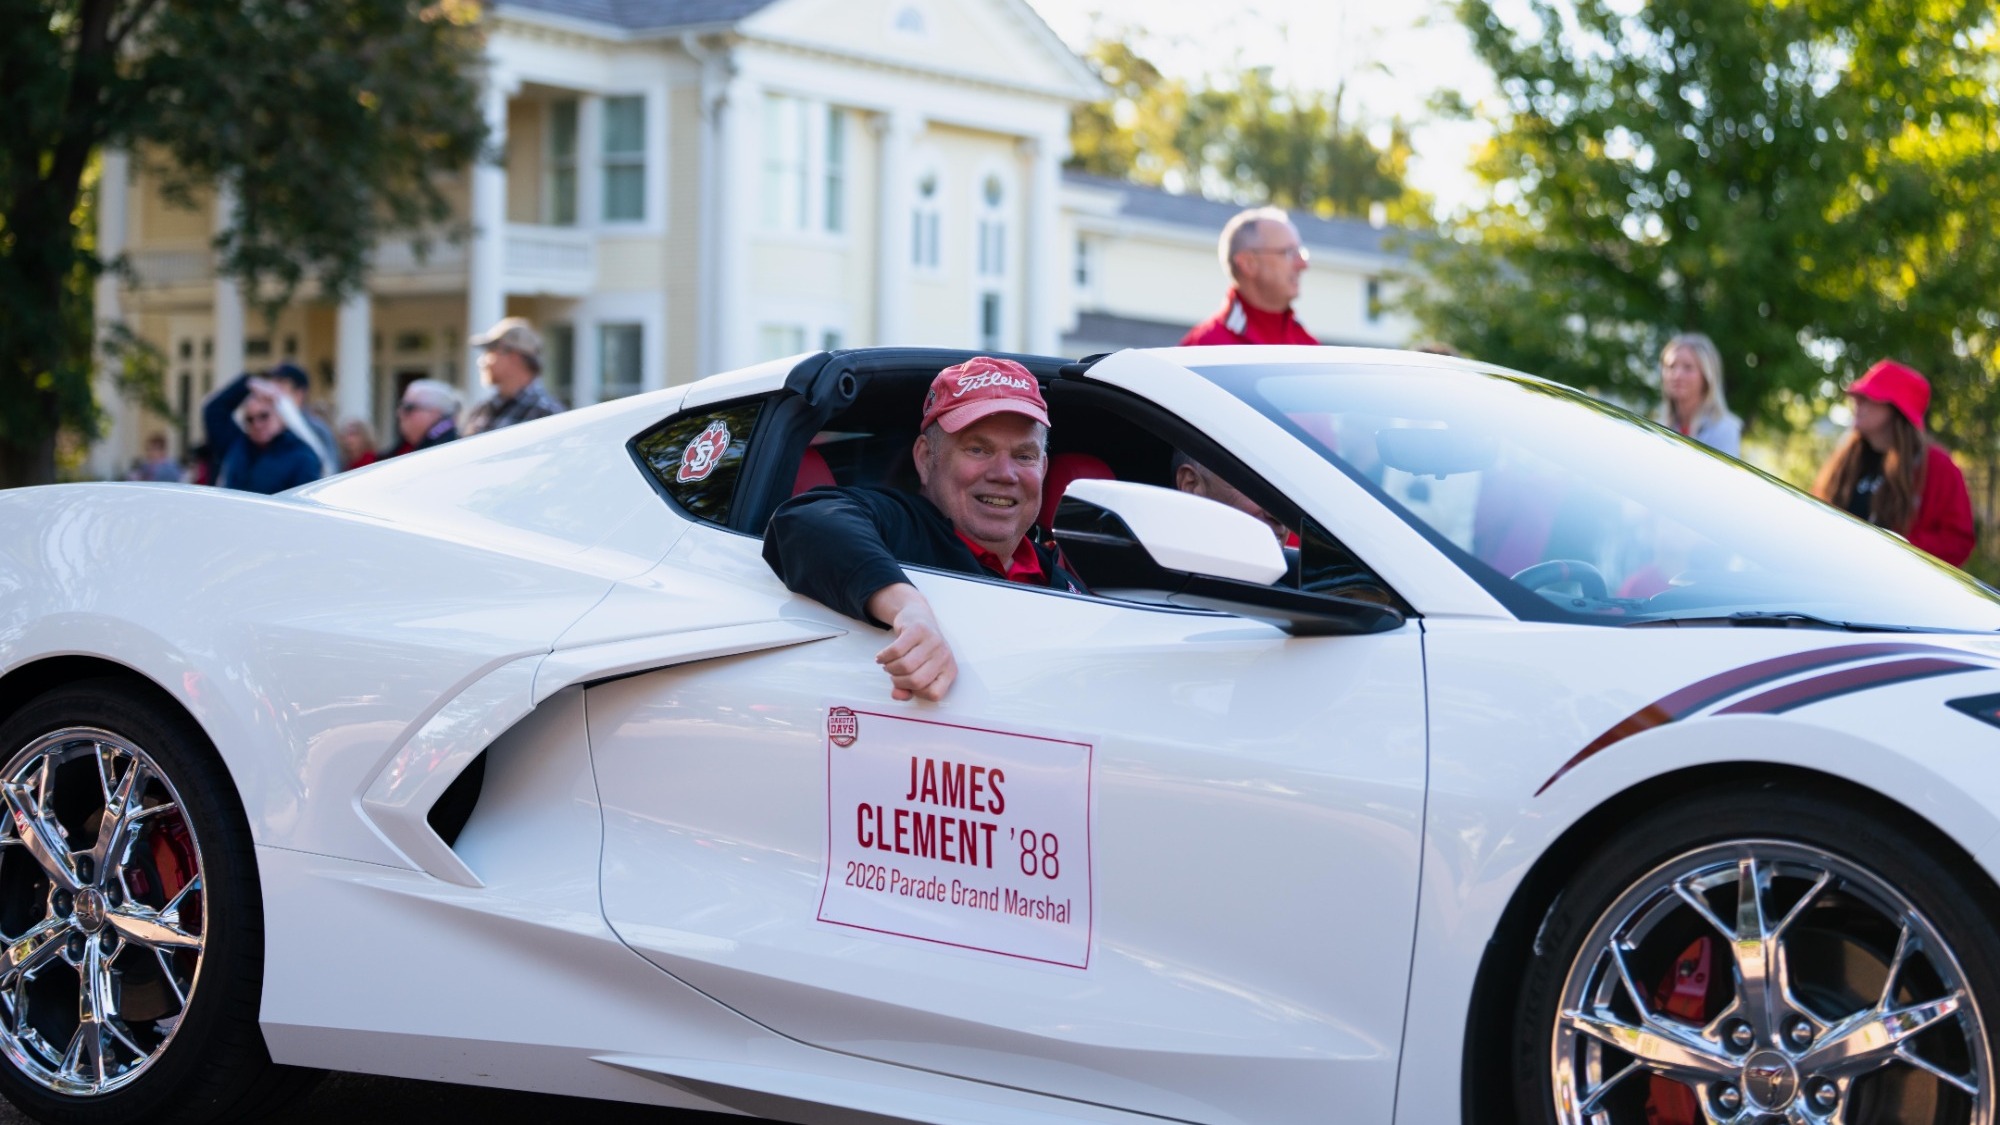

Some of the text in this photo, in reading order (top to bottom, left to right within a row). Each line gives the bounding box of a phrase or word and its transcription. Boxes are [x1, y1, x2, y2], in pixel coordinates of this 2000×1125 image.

[953, 370, 1031, 398] Titleist
[830, 724, 854, 734] DAYS
[906, 756, 1006, 816] JAMES
[856, 802, 1061, 880] CLEMENT '88
[845, 861, 1071, 924] 2026 Parade Grand Marshal
